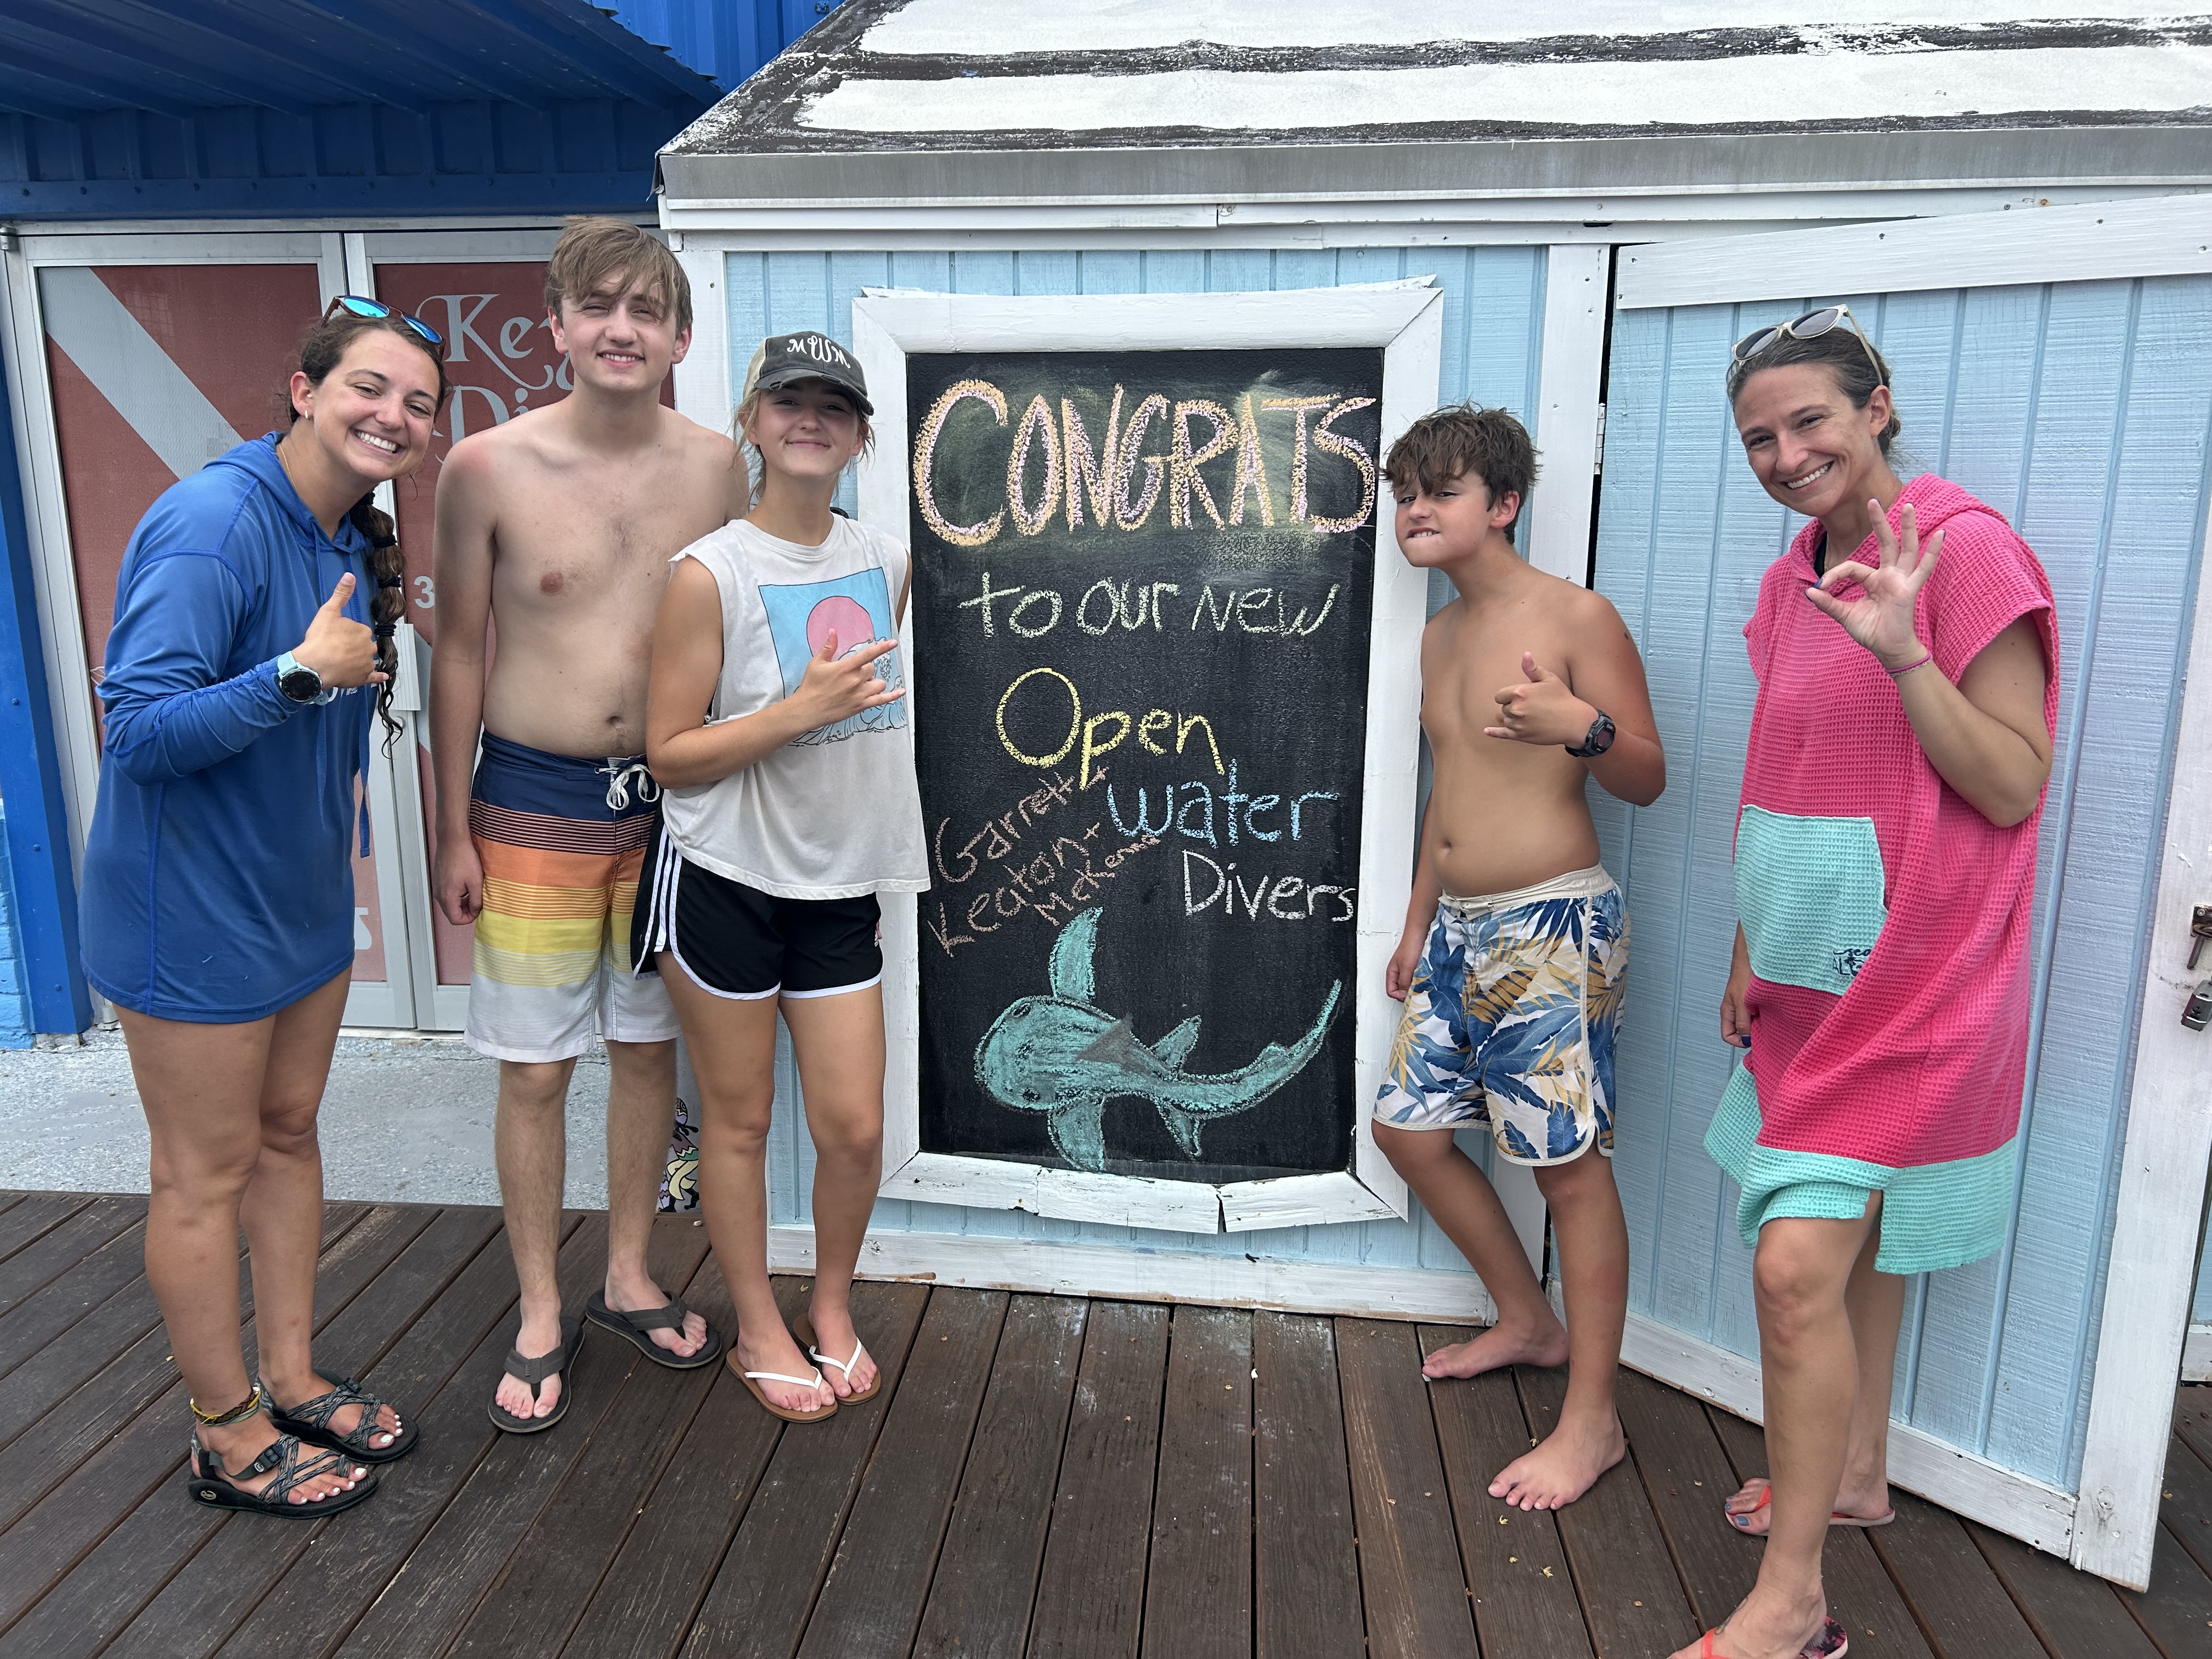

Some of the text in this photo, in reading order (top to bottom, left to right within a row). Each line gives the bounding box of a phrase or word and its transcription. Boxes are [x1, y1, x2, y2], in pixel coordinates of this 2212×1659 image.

[913, 379, 1376, 546] CONGRATS
[957, 572, 1063, 638] to
[1076, 577, 1180, 636] our
[996, 667, 1225, 791] Open
[935, 771, 1076, 883] Garrett
[1182, 849, 1359, 922] Divers
